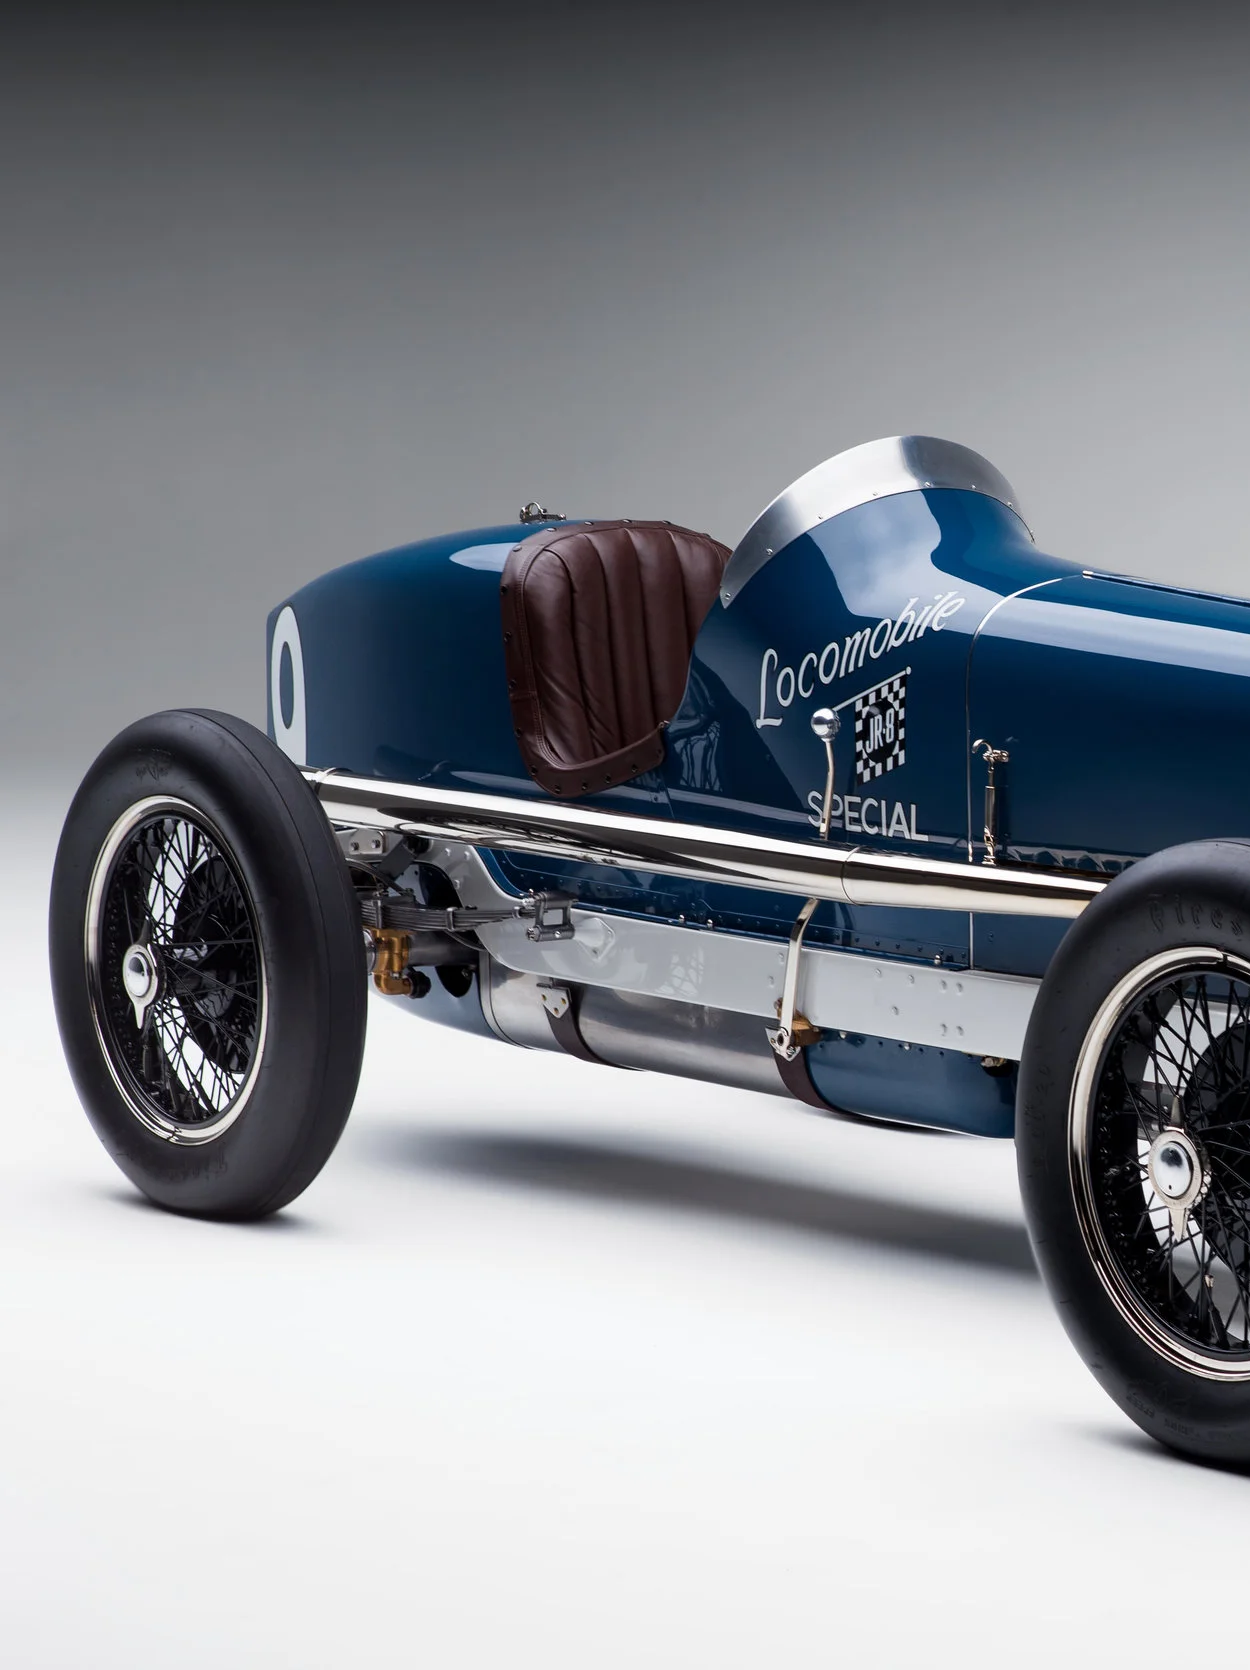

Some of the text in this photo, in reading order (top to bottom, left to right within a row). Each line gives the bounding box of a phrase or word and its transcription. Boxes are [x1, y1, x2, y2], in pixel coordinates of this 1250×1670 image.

[271, 605, 307, 766] 0
[756, 591, 965, 729] Locomobile
[808, 790, 928, 841] SPECIAL
